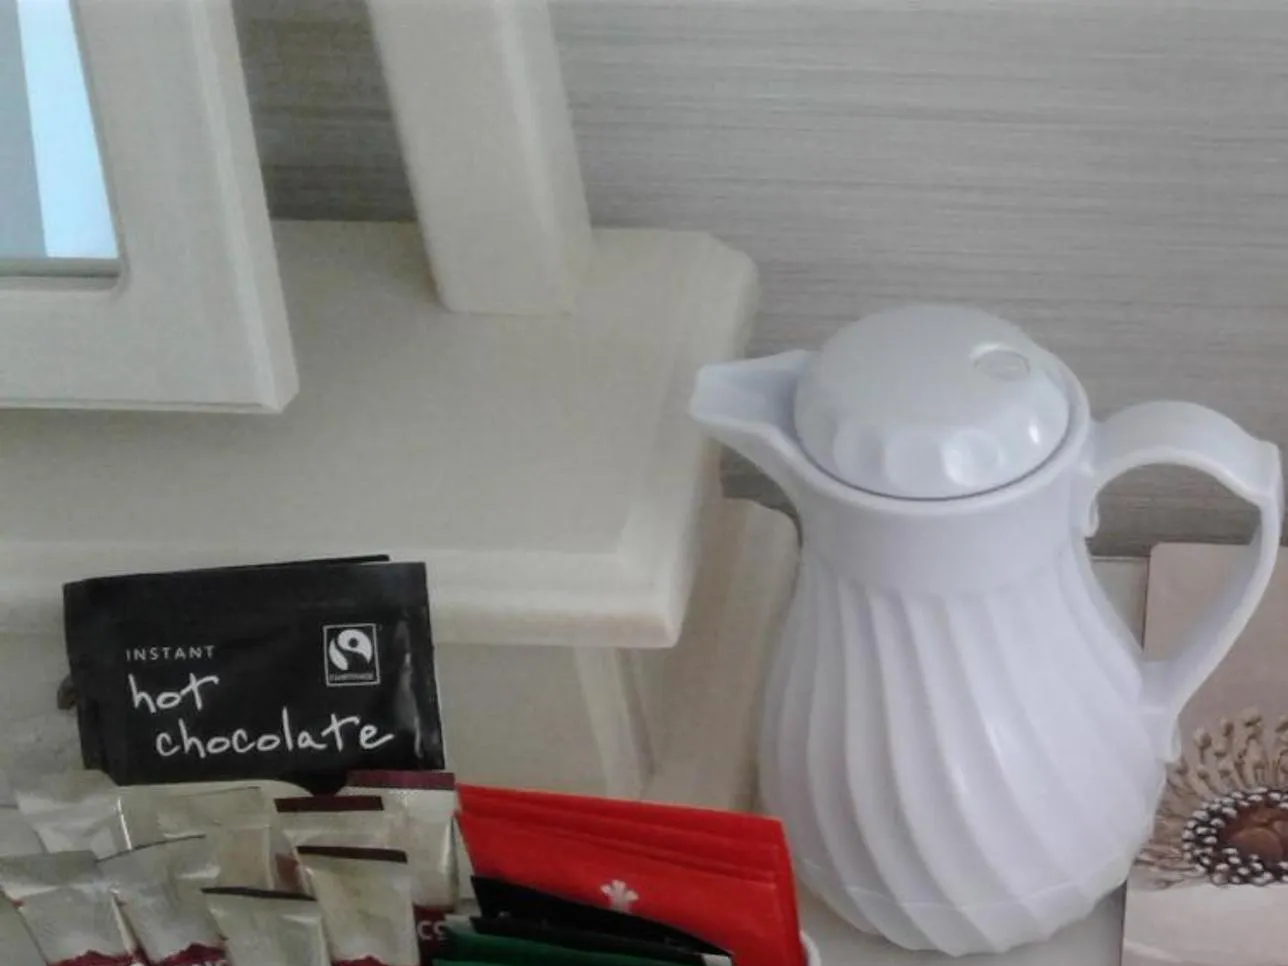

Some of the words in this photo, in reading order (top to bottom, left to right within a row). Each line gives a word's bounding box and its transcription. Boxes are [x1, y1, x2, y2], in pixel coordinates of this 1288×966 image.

[126, 644, 216, 662] INSTANT
[129, 673, 219, 713] hot
[155, 706, 395, 758] chocolate
